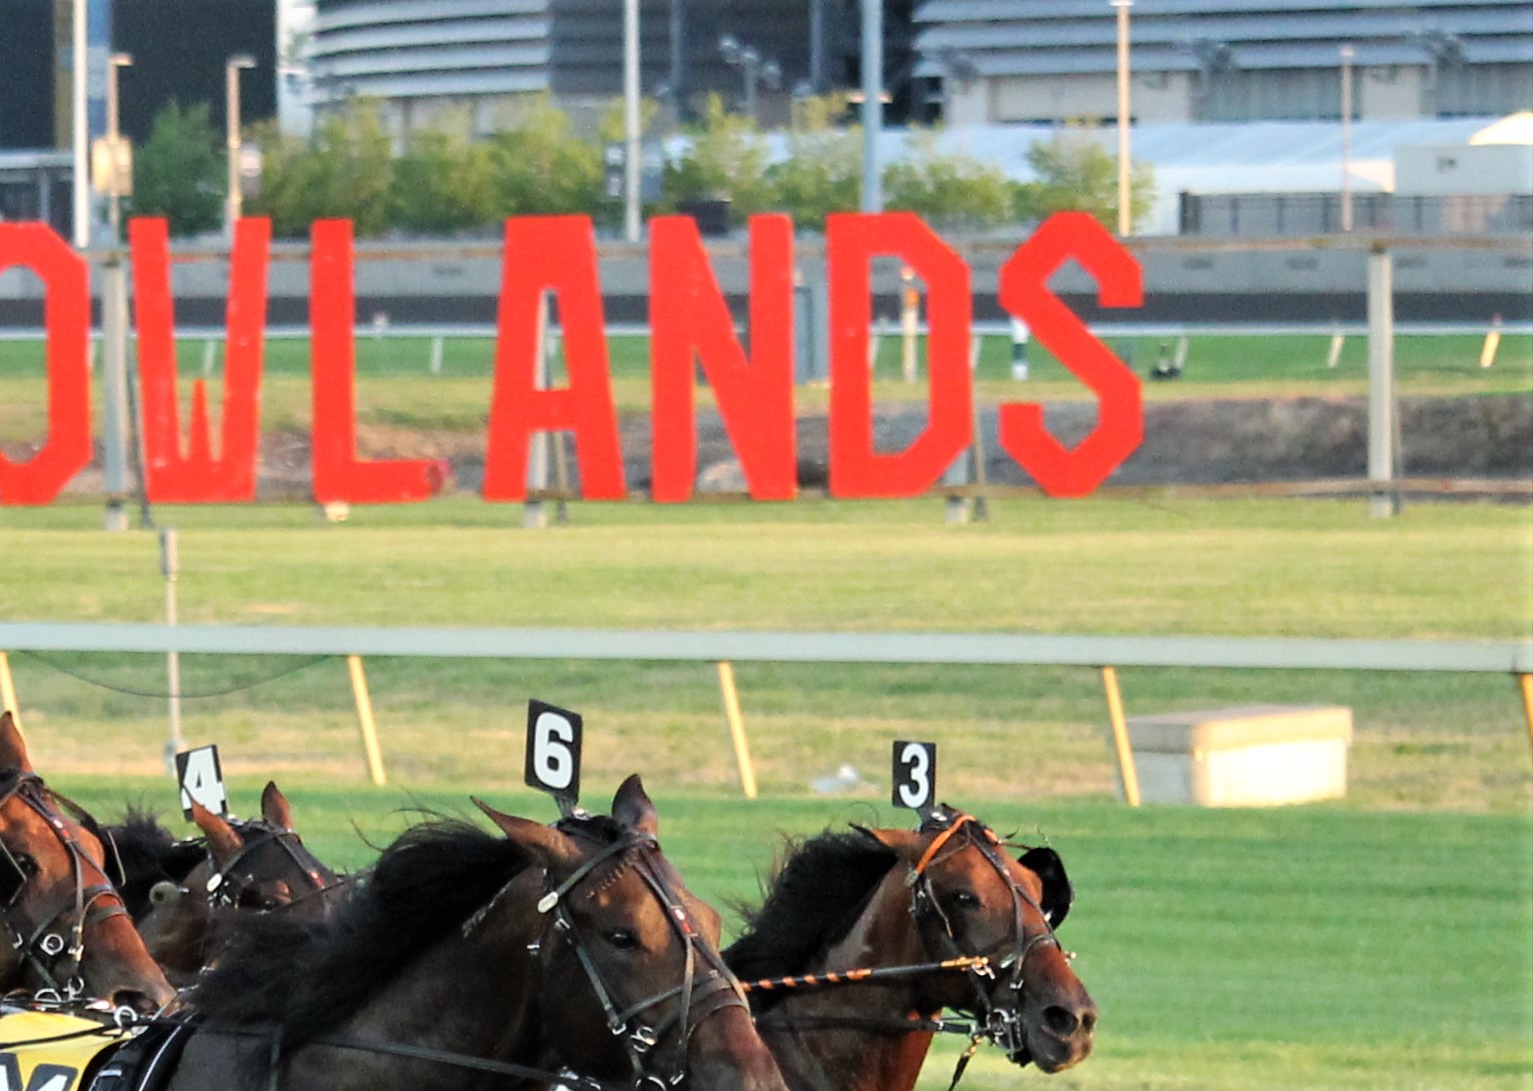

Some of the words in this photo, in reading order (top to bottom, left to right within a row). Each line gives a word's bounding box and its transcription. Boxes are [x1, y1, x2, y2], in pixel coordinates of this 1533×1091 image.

[184, 746, 228, 816] 4
[533, 711, 575, 790] 6
[898, 743, 931, 809] 3
